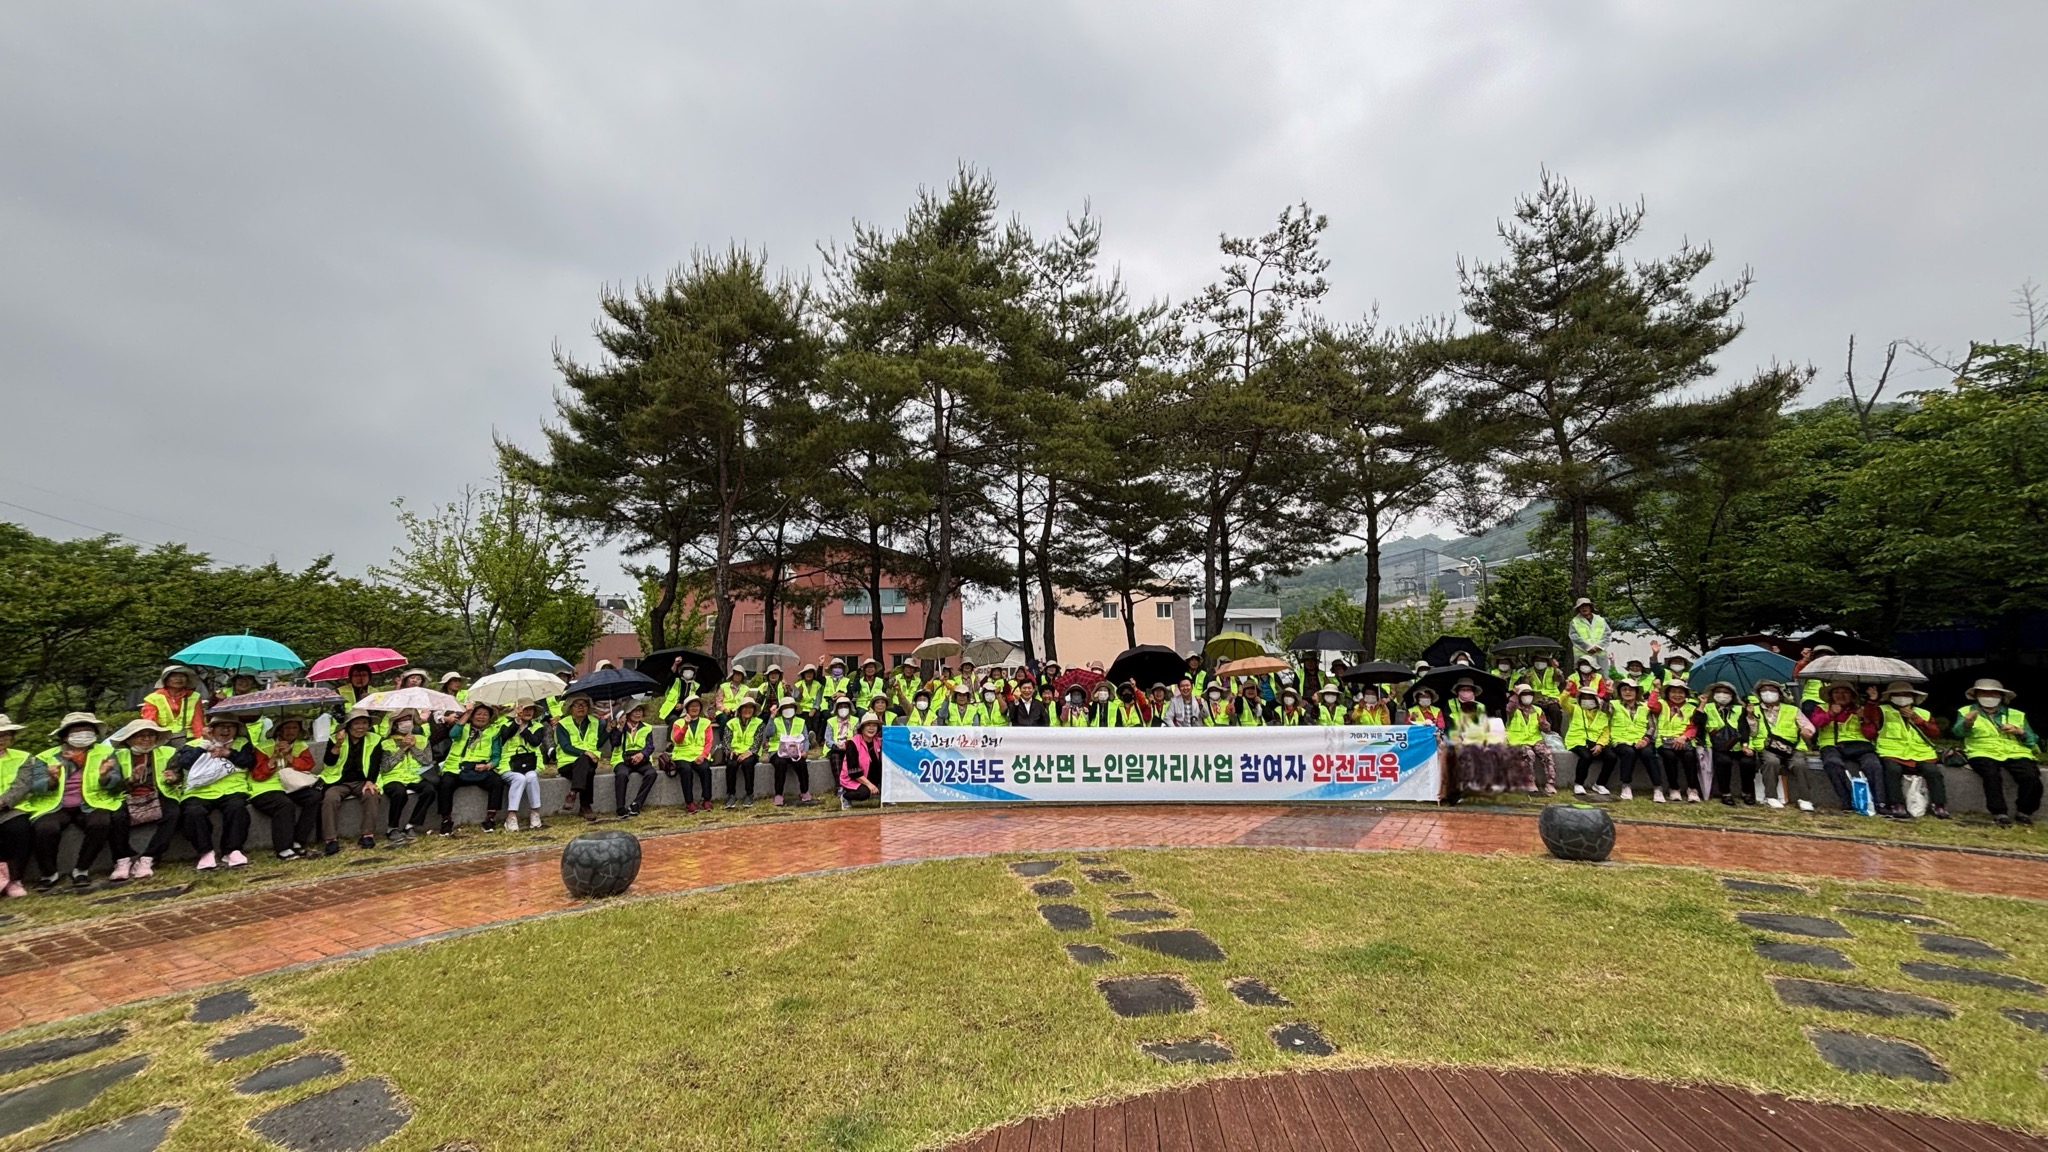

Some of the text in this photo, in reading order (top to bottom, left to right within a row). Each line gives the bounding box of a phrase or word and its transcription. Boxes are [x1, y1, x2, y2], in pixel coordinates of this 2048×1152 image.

[1385, 732, 1408, 749] 고령
[919, 752, 1399, 784] 2025년도 성산면 노인일자리사업 참여자 안전교육
